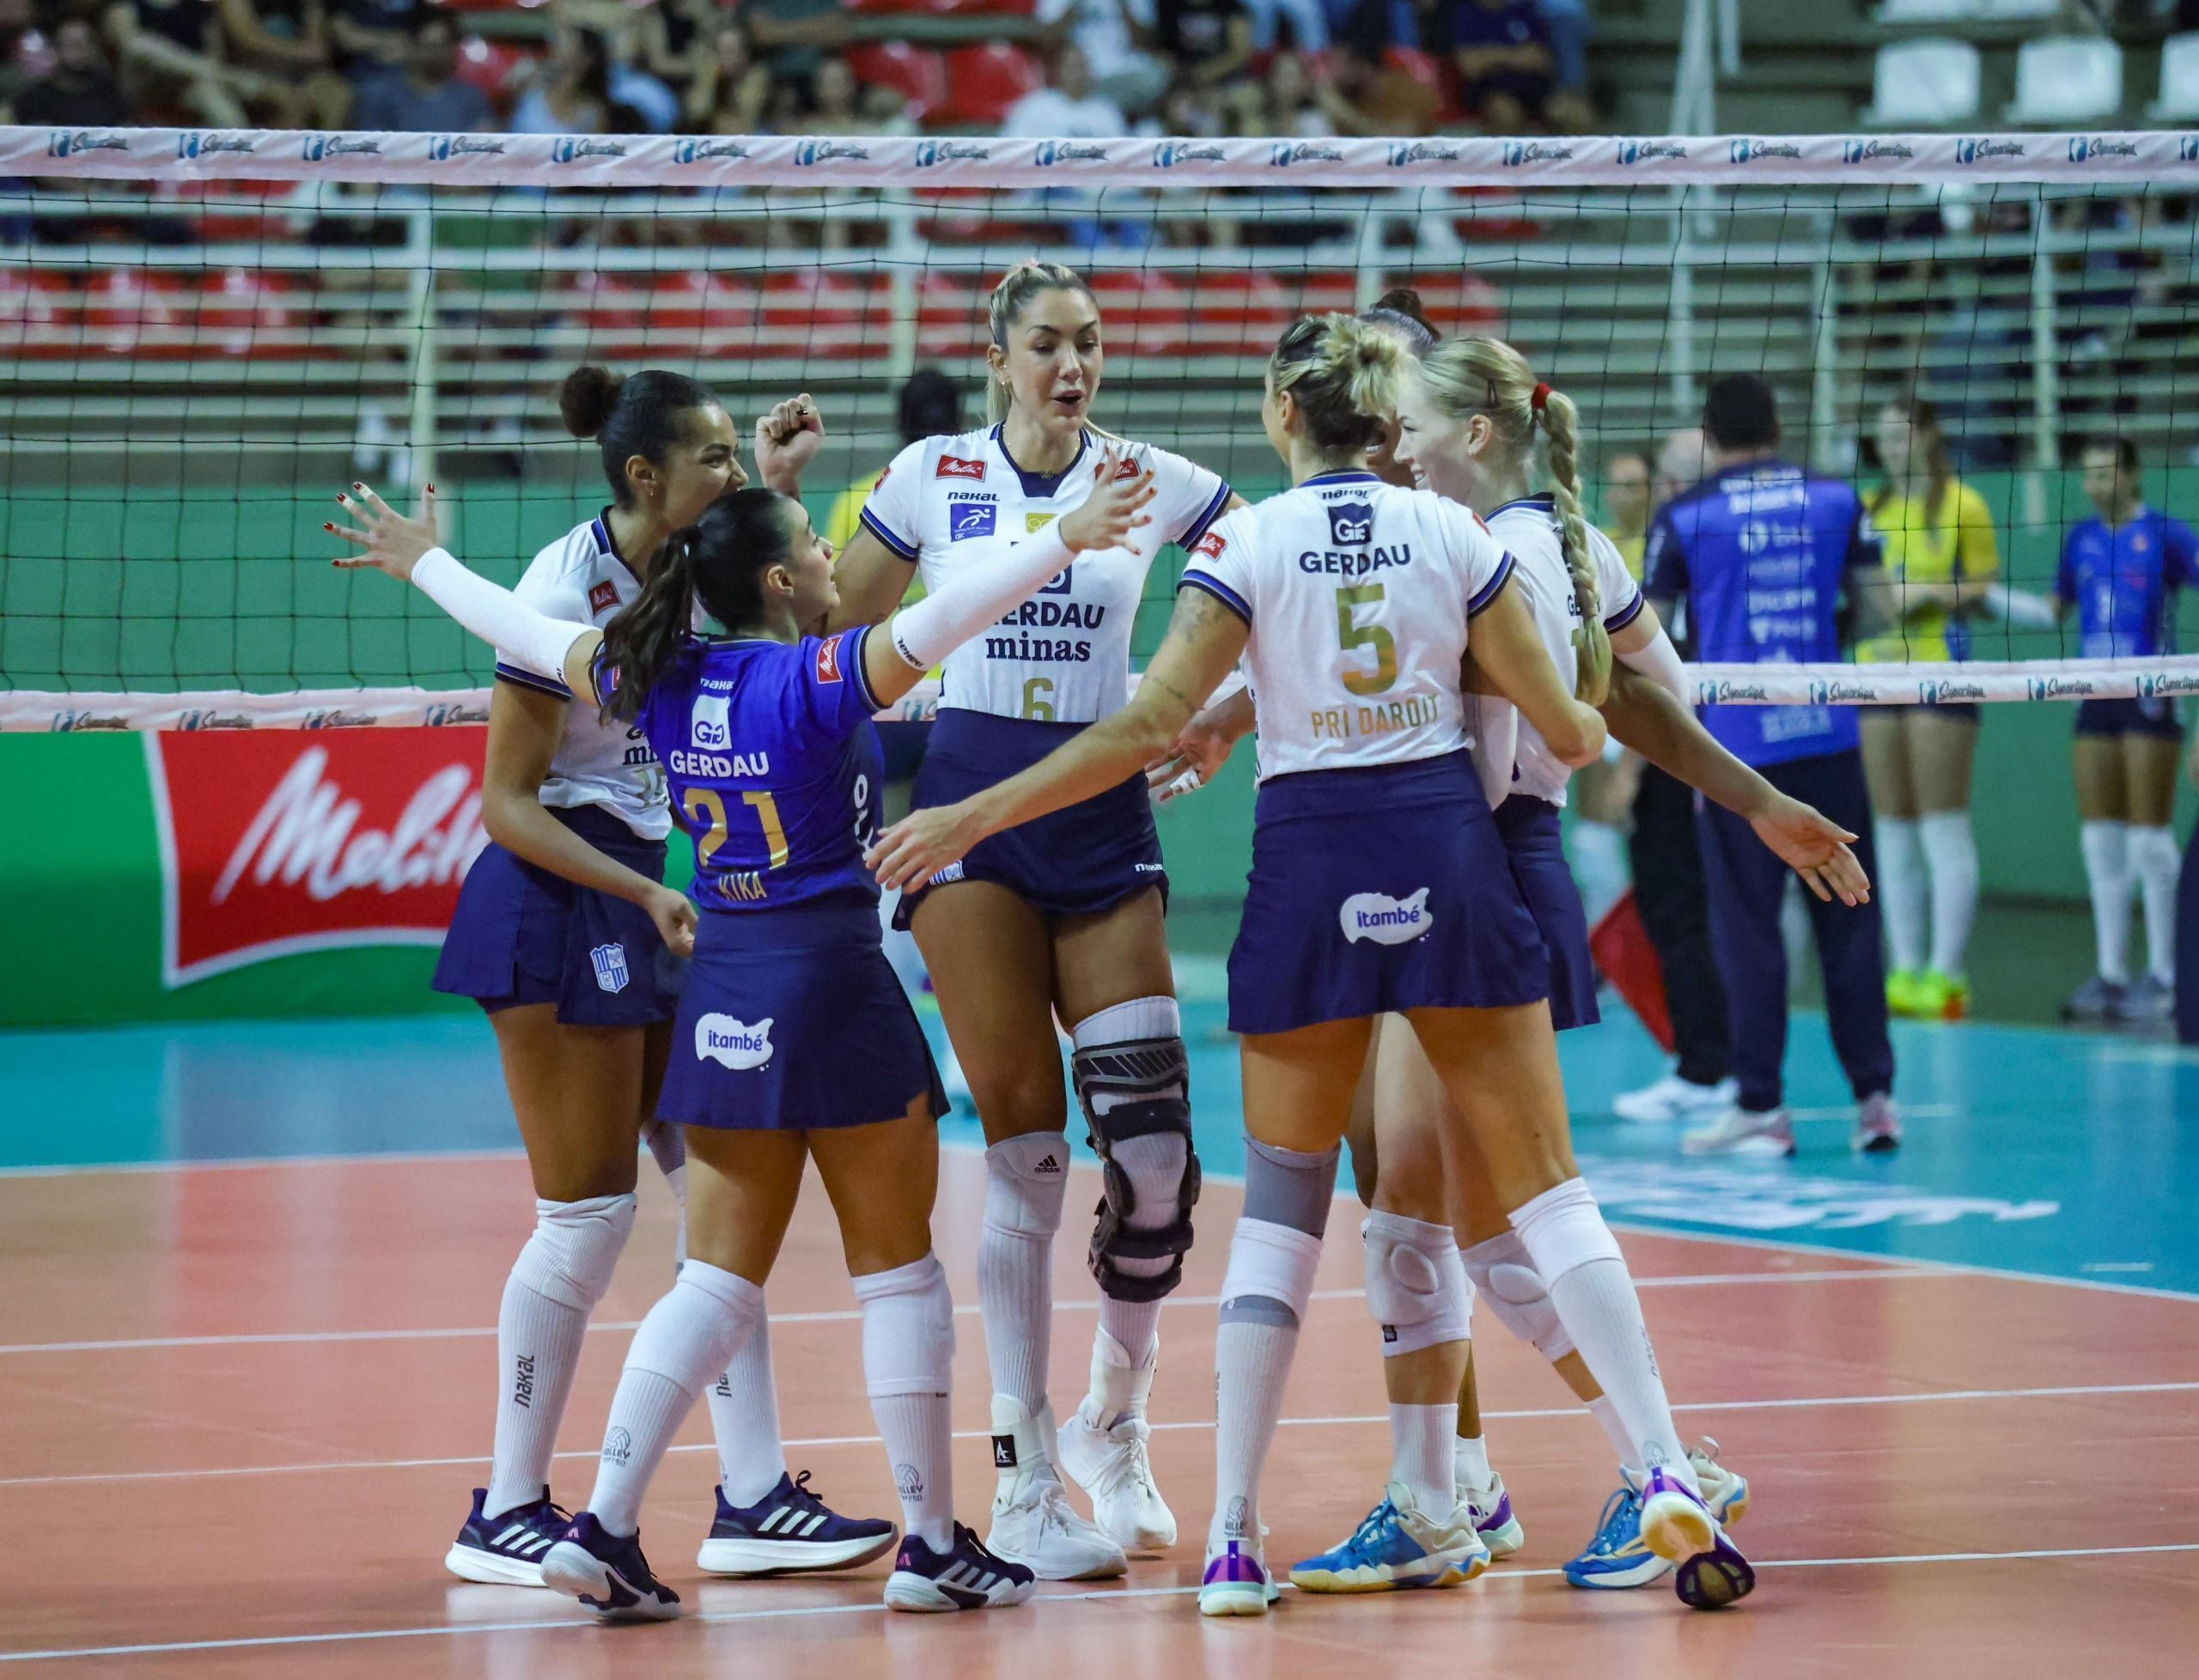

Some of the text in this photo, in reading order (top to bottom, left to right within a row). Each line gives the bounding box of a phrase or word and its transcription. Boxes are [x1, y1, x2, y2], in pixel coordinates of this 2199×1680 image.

[1300, 544, 1410, 575] GERDAU
[994, 600, 1105, 630] ERDAU
[986, 630, 1091, 662] minas
[1336, 583, 1398, 696] 5
[1023, 677, 1054, 721] 6
[1311, 693, 1439, 739] PRI DAROIT
[670, 750, 770, 778] GERDAU
[684, 788, 789, 869] 21
[718, 870, 768, 901] KIKA
[1357, 904, 1421, 928] itambé
[708, 1029, 764, 1051] itambé
